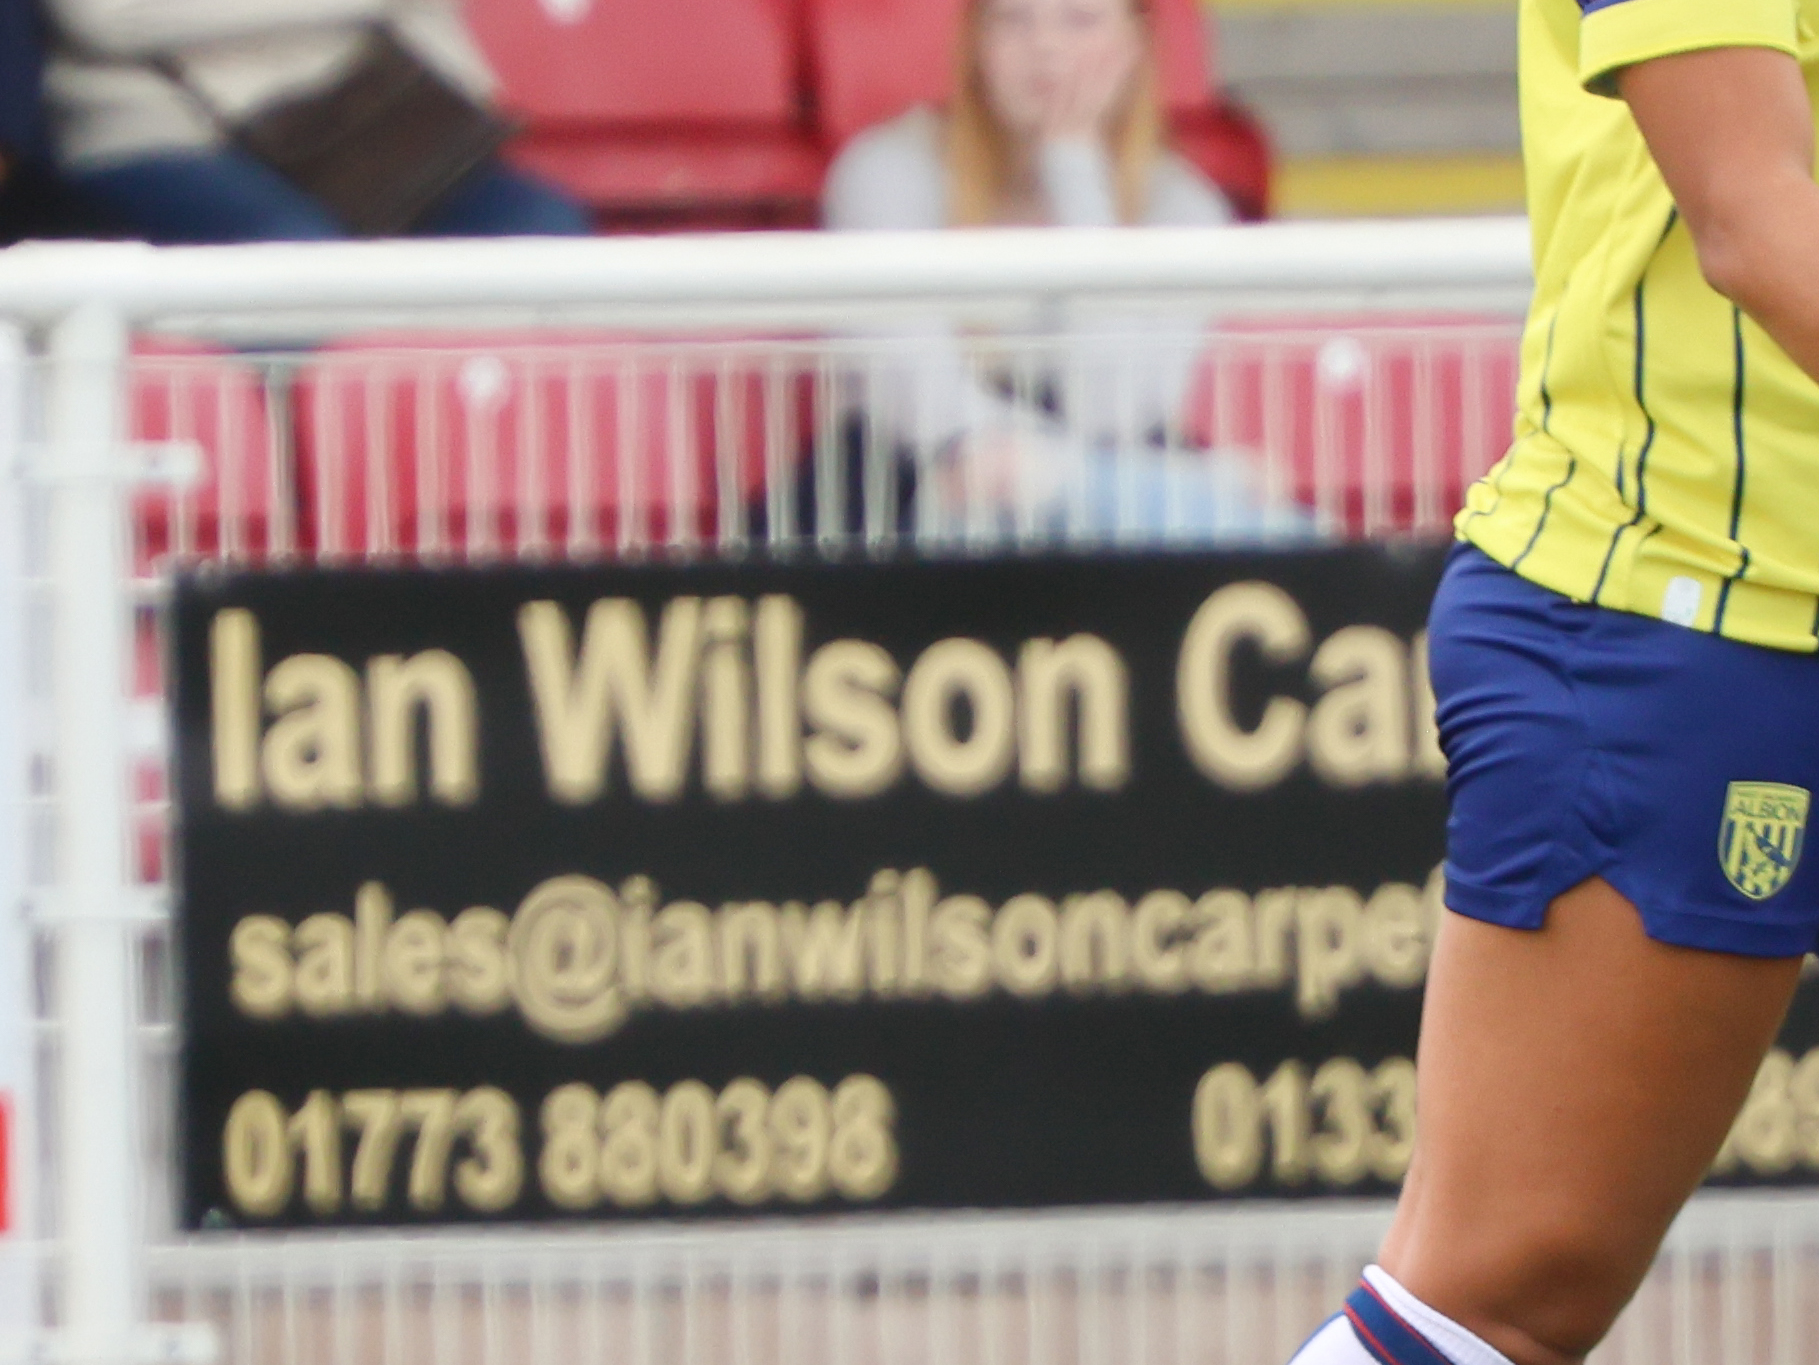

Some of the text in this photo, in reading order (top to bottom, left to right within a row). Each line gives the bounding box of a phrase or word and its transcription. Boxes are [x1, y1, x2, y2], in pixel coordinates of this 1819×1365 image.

[209, 605, 481, 811] Ian
[517, 592, 1132, 803] Wilson
[223, 1073, 899, 1215] 01773 880398
